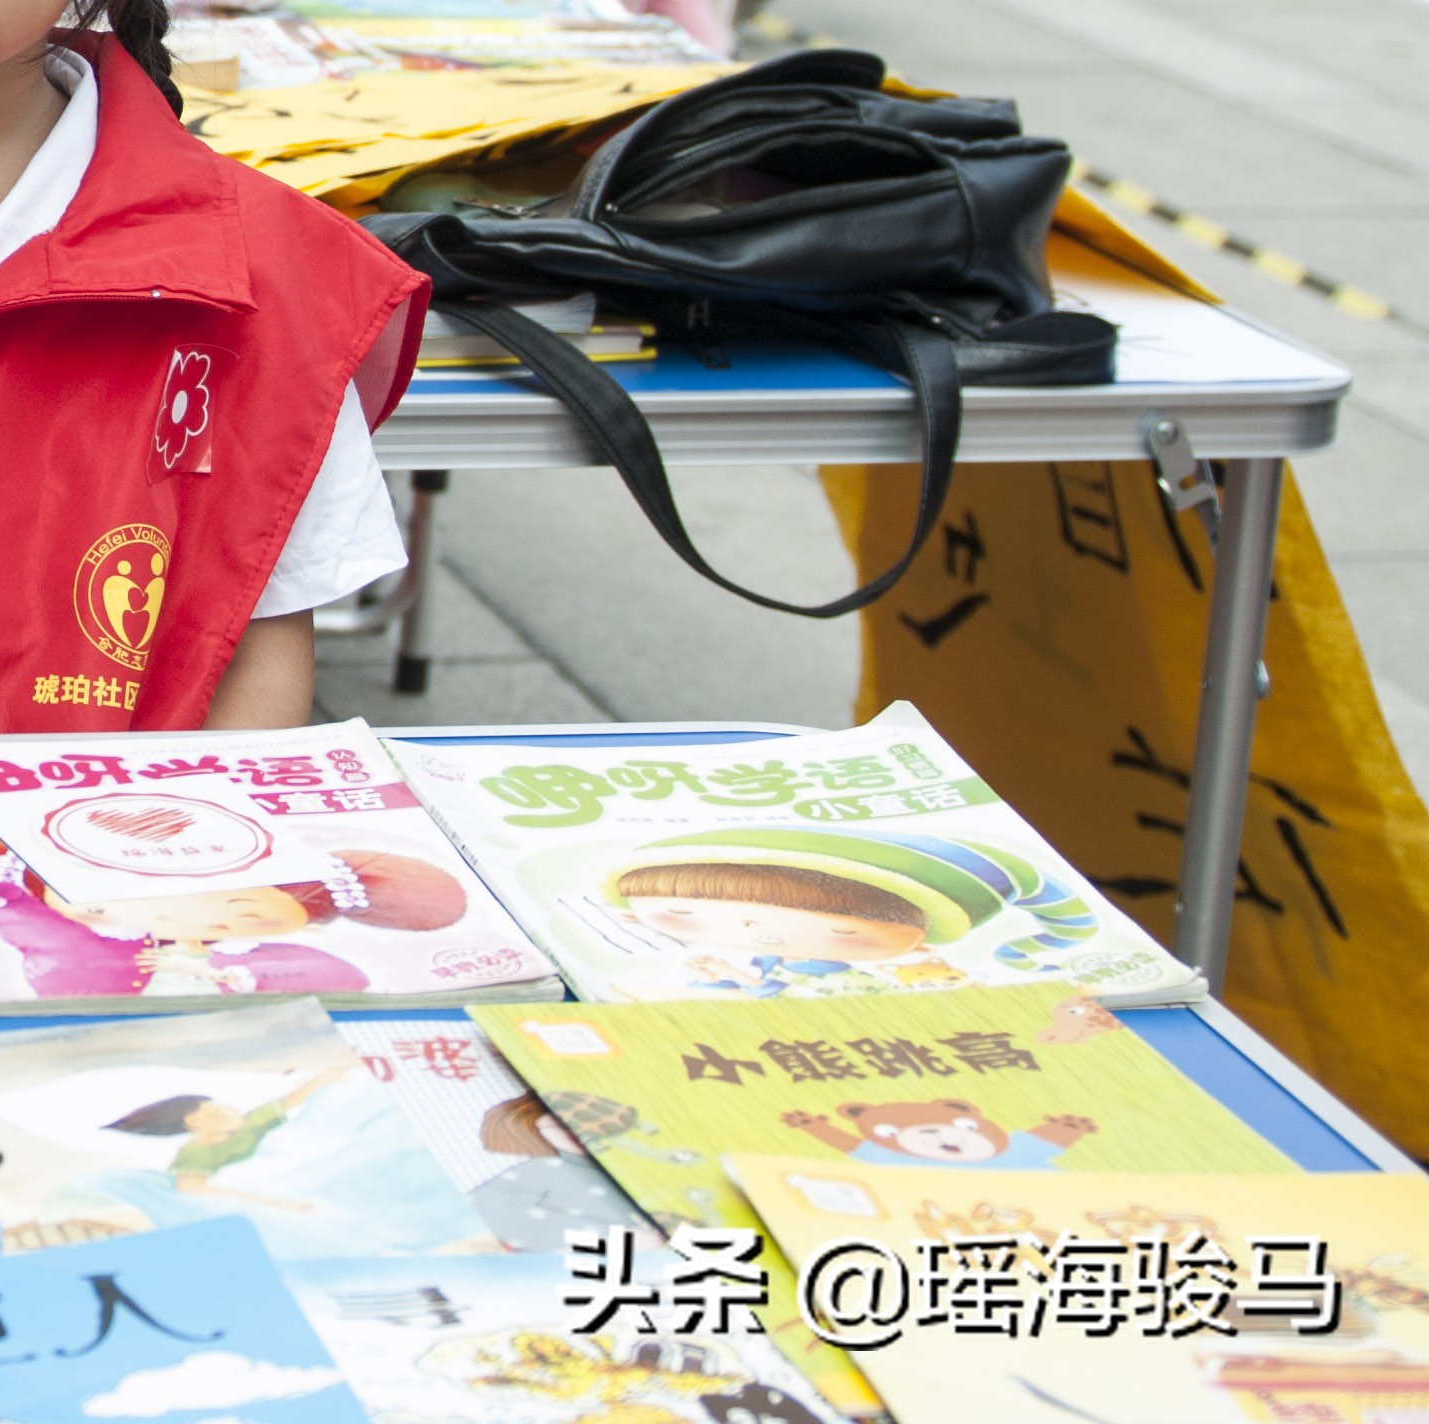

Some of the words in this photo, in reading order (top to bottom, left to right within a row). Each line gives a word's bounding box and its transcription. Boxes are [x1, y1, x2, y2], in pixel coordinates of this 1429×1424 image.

[87, 529, 129, 566] Hefei
[809, 784, 970, 821] 小童话
[681, 1032, 1042, 1085] 小熊跳高
